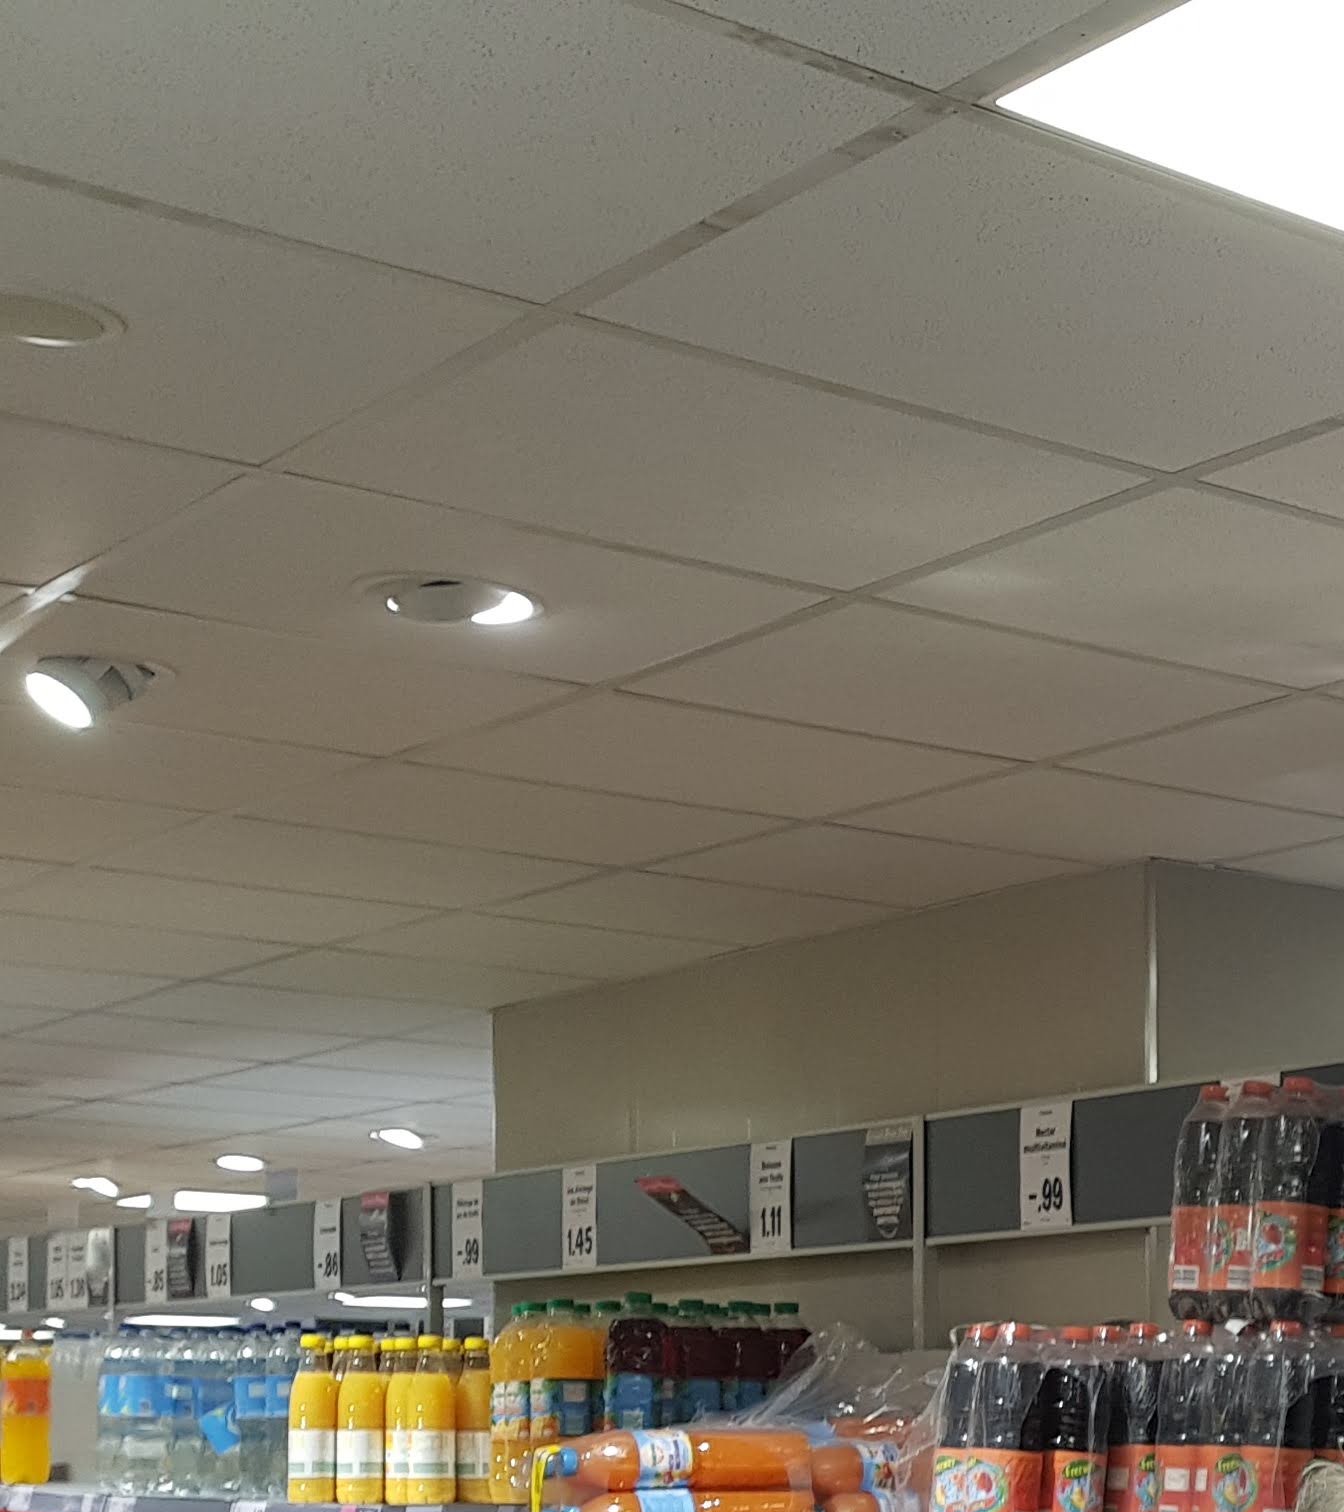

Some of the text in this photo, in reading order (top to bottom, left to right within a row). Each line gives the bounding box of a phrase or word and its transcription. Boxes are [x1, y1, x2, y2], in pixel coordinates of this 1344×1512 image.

[1028, 1177, 1063, 1212] -.99
[761, 1206, 782, 1237] 1.11
[567, 1226, 593, 1256] 1.45
